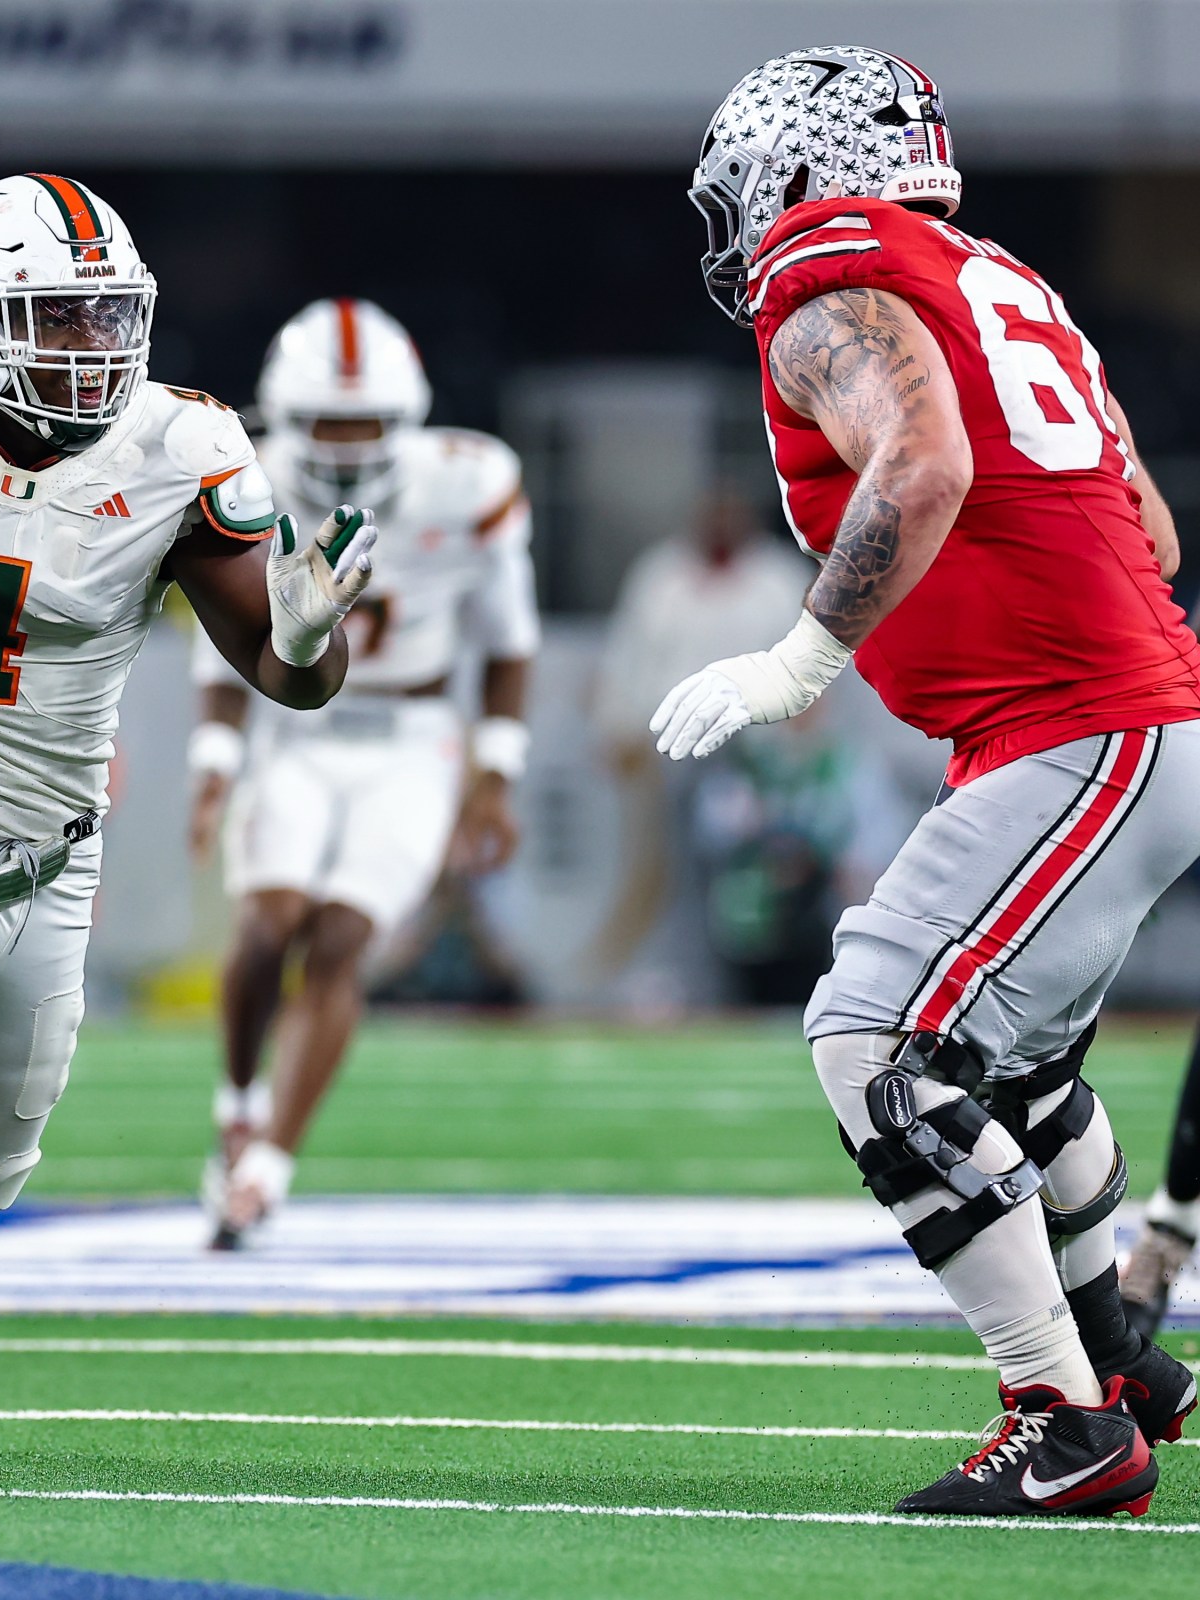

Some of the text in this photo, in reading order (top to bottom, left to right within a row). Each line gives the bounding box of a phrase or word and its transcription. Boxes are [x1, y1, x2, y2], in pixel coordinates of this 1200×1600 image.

[910, 149, 925, 163] 67
[75, 265, 116, 278] MIAMI
[0, 474, 36, 500] U
[891, 1079, 905, 1125] DONJOY
